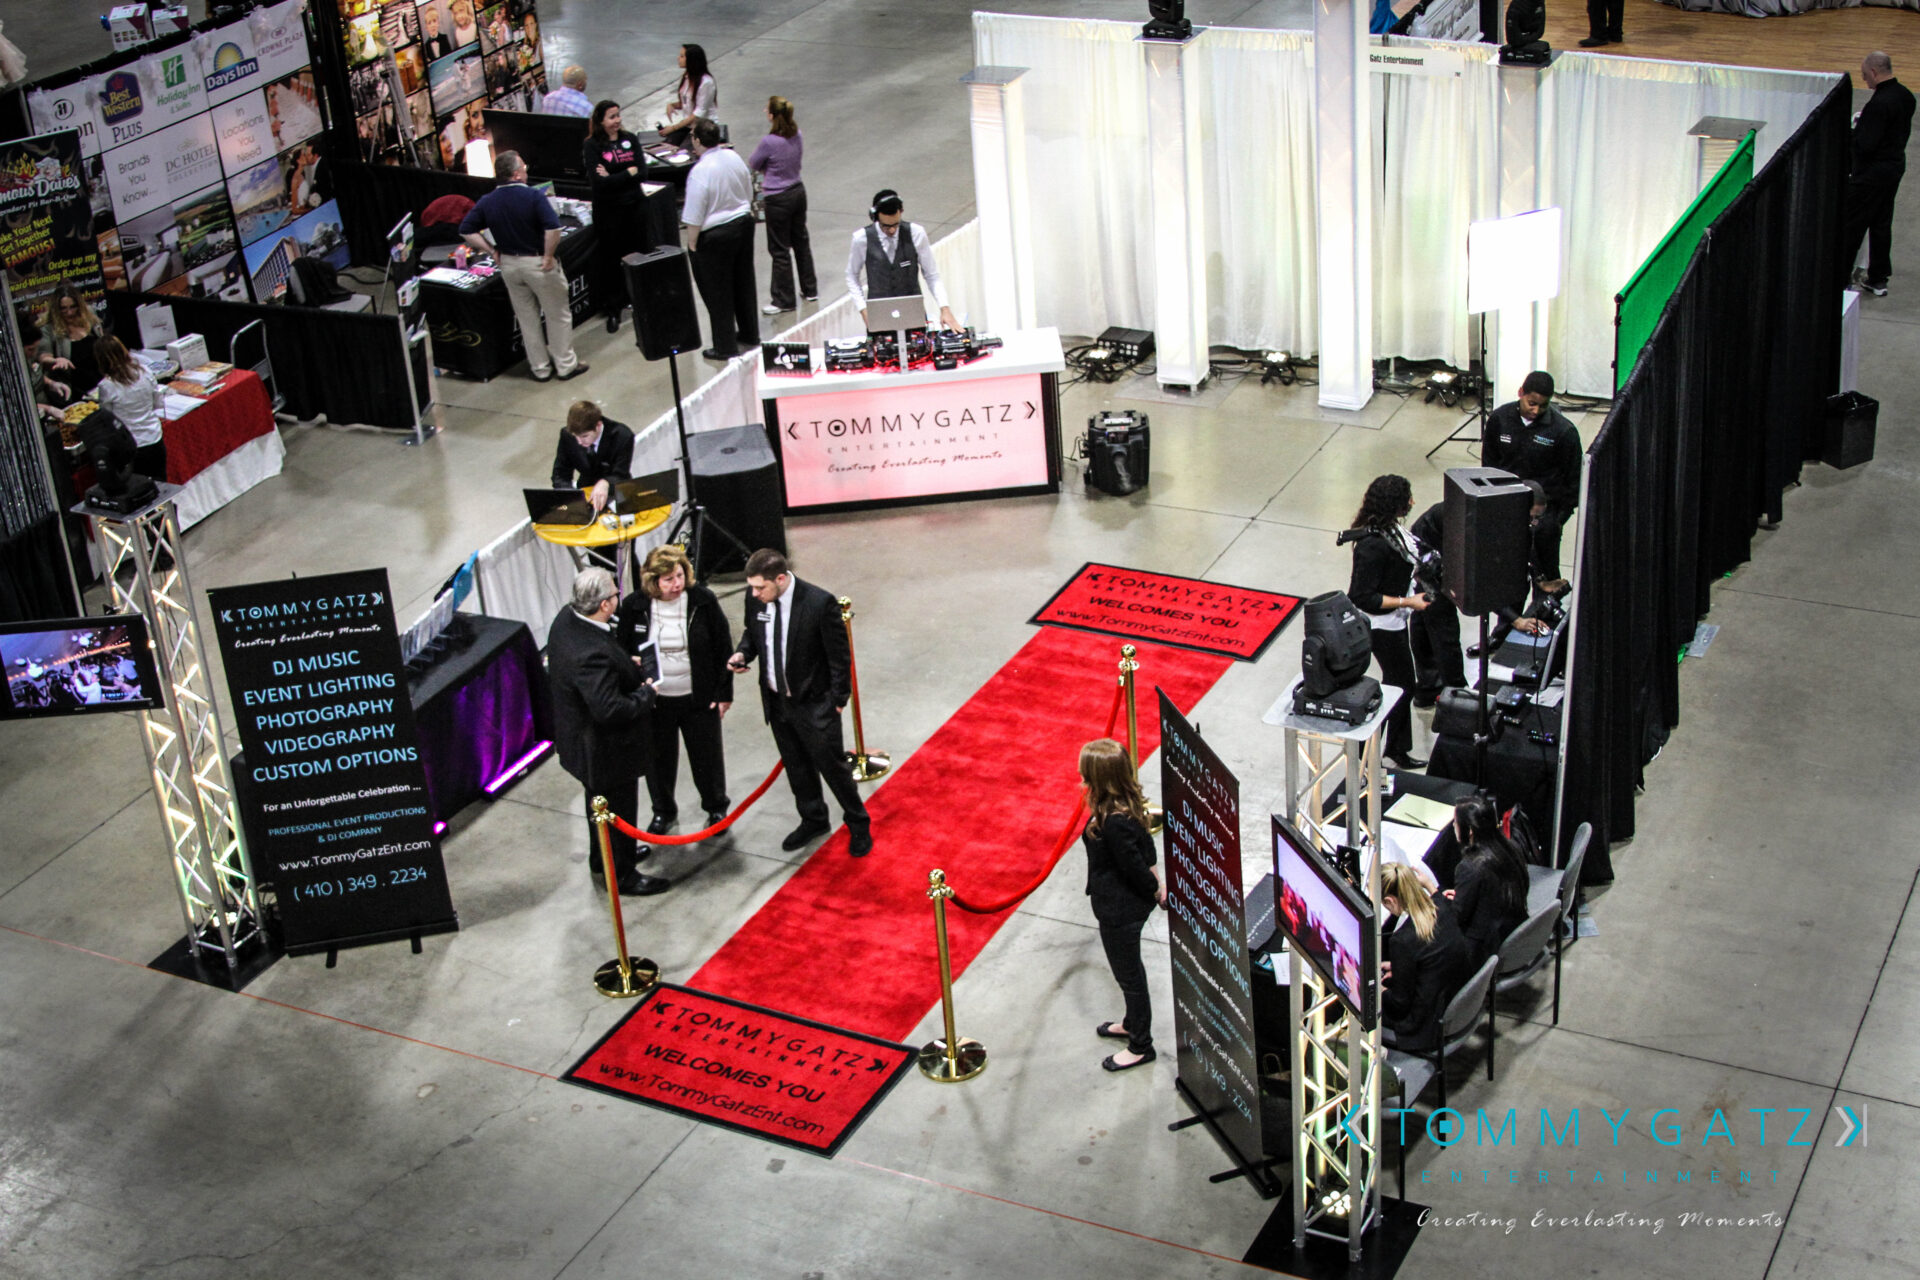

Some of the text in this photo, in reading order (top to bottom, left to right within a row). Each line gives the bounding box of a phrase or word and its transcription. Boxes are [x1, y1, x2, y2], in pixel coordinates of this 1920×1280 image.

[1383, 55, 1424, 66] Entertainment
[206, 61, 257, 90] Days Inn
[103, 96, 141, 117] Western
[109, 88, 130, 103] Best
[156, 83, 200, 106] Holiday Inn
[112, 120, 143, 144] PLUS
[222, 114, 265, 139] Locations
[238, 135, 255, 147] You
[118, 153, 151, 175] Brands
[165, 144, 216, 173] DC HOTEL
[237, 146, 262, 163] Need
[34, 174, 80, 198] Dave's
[128, 173, 147, 186] You
[12, 223, 32, 237] Your
[33, 215, 53, 229] Next
[15, 228, 50, 248] Together
[4, 238, 56, 268] FAMOUS!
[48, 252, 97, 271] Order up my
[9, 272, 61, 293] ward-Winning
[63, 263, 99, 279] Barbecue
[827, 450, 1003, 473] Creating Everlasting Moments
[1089, 596, 1239, 629] WELCOMES YOU
[234, 623, 382, 649] Creating Everlasting Moments
[1056, 608, 1246, 648] www.TommyGatzEnt.com
[272, 650, 361, 677] DJ MUSIC
[243, 673, 396, 707] EVENT LIGHTING
[255, 698, 395, 731] PHOTOGRAPHY
[264, 723, 396, 755] VIDEOGRAPHY
[252, 747, 418, 783] CUSTOM OPTIONS
[263, 802, 279, 813] For
[280, 801, 292, 811] an
[293, 792, 357, 811] Unforgettable
[358, 782, 411, 799] Celebration
[268, 806, 426, 836] PROFESSIONAL EVENT PRODUCTIONS
[326, 833, 337, 843] DJ
[338, 825, 382, 841] COMPANY
[1182, 799, 1226, 861] DJ MUSIC
[279, 838, 431, 872] www.TommyGatzEnt.com
[1166, 810, 1196, 854] EVENT
[1197, 846, 1241, 908] LIGHTING
[391, 867, 427, 885] 2234
[1172, 842, 1240, 932] PHOTOGRAPHY
[1175, 872, 1241, 959] VIDEOGRAPHY
[1168, 892, 1207, 949] CUSTOM
[1209, 938, 1251, 999] OPTIONS
[643, 1043, 827, 1104] WELCOMES YOU
[599, 1062, 825, 1135] www.TommyGatzEnt.com
